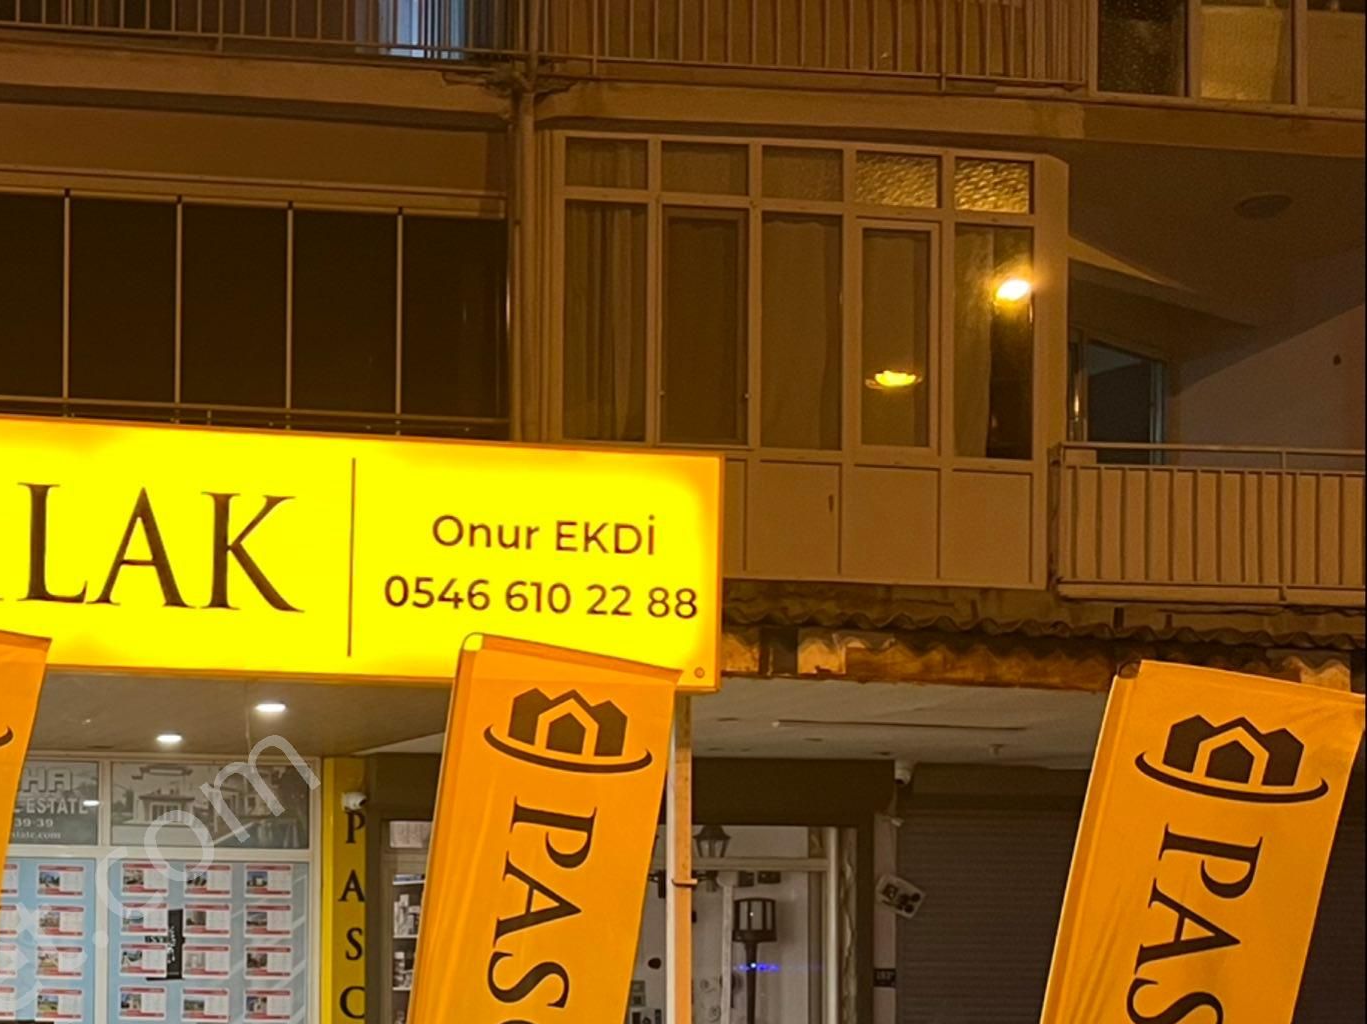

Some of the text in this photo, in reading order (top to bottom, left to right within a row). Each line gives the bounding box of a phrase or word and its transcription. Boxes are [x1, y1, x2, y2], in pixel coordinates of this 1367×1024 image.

[432, 514, 540, 549] Onur
[384, 575, 698, 619] 0546 610 22 88
